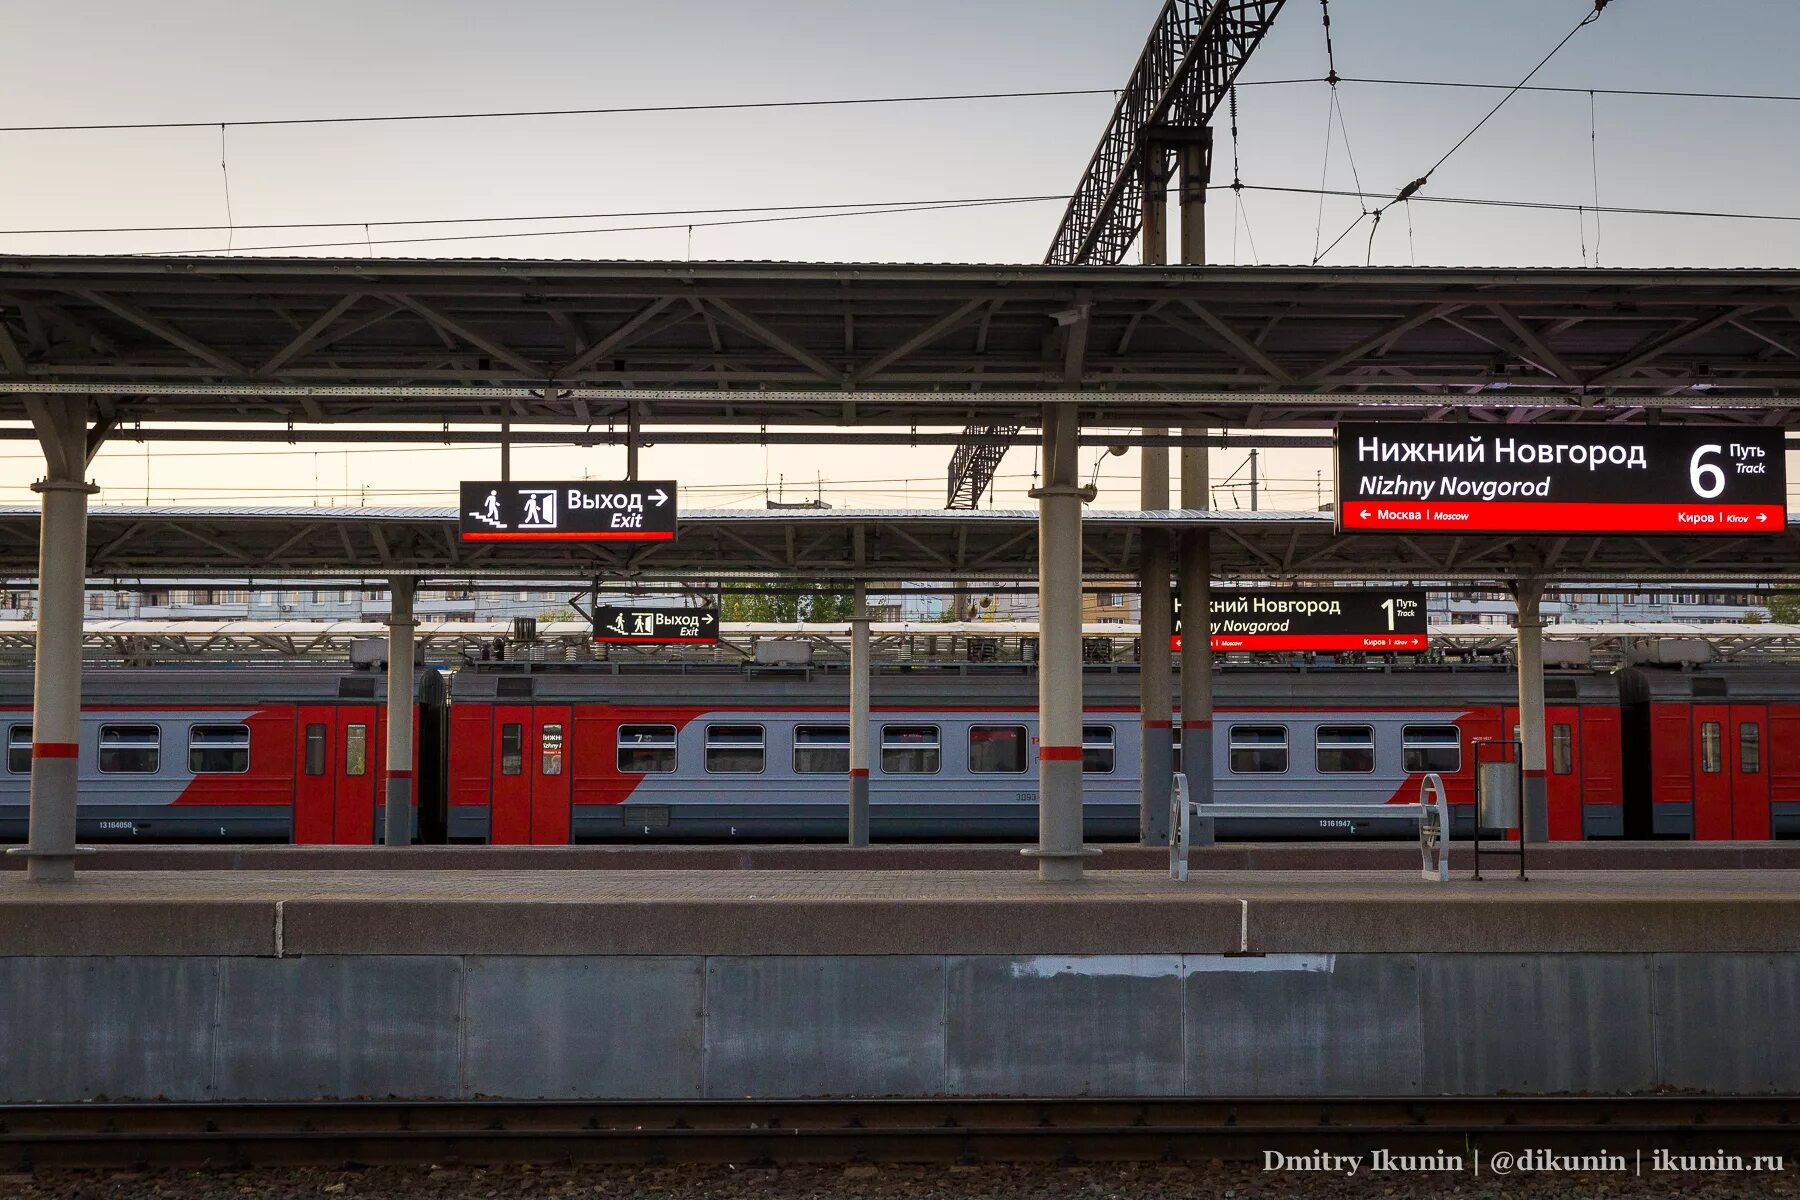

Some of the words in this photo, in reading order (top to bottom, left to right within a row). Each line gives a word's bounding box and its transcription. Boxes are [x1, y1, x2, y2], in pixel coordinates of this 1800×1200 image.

[1359, 436, 1484, 462] Нижний
[1496, 438, 1646, 470] Новгород
[1730, 444, 1765, 460] Путь
[1690, 445, 1725, 498] 6
[1736, 463, 1765, 473] Track
[1359, 475, 1436, 500] Nizhny
[1440, 476, 1550, 500] Novgorod
[567, 489, 644, 512] Выход
[610, 513, 644, 528] Exit
[1378, 510, 1421, 520] Москва
[1434, 512, 1469, 520] Moscow
[1678, 512, 1715, 523] Киров
[1175, 597, 1247, 612] Нний
[1254, 598, 1340, 616] Новгород
[1397, 599, 1417, 608] Путь
[656, 614, 699, 627] Выход
[1380, 598, 1395, 631] 1
[1397, 609, 1415, 617] Track
[679, 626, 699, 636] Exit
[1224, 619, 1289, 634] Novgorod
